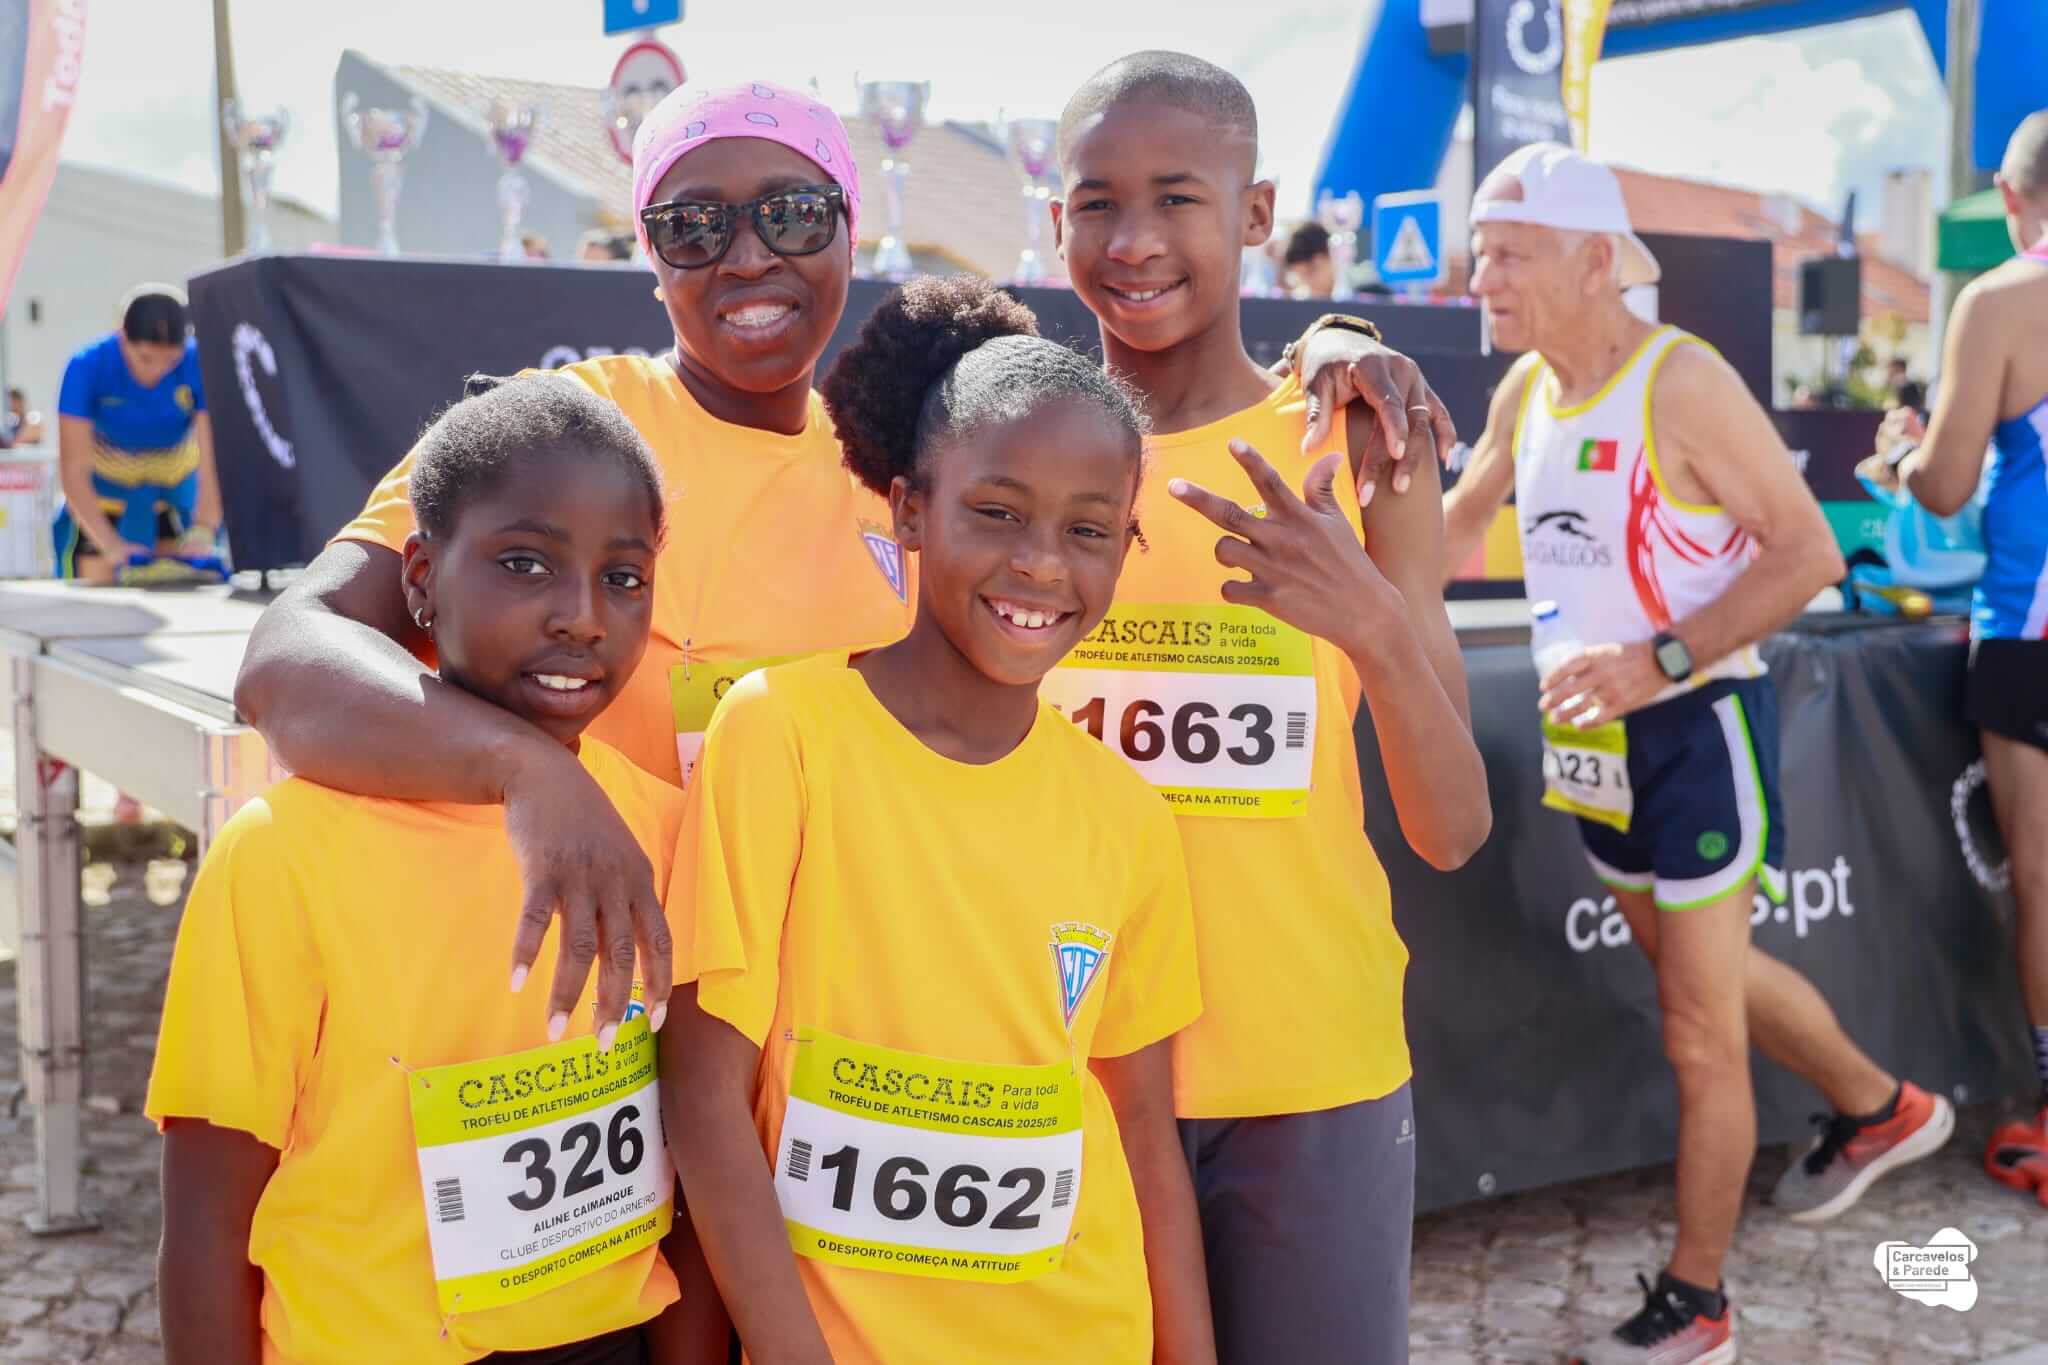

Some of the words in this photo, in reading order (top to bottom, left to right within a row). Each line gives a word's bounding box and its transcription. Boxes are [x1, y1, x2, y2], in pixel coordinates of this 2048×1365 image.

[1082, 619, 1212, 646] ASCAIS
[1219, 622, 1248, 634] Para
[1250, 624, 1277, 635] toda
[1219, 639, 1227, 648] a
[1231, 636, 1257, 648] vida
[1073, 648, 1113, 661] TROFÉU
[1115, 652, 1129, 662] DE
[1130, 652, 1185, 663] ATLETISMO
[1186, 652, 1235, 665] CASCAIS
[1236, 655, 1280, 666] 2025/26
[1071, 697, 1276, 766] 1663
[1160, 792, 1193, 805] MEÇA
[1195, 794, 1211, 804] NA
[1214, 795, 1261, 806] ATITUDE
[614, 1040, 633, 1055] Para
[633, 1031, 648, 1046] toda
[616, 1060, 622, 1070] a
[623, 1051, 639, 1067] vida
[458, 1050, 609, 1108] CASCAIS
[462, 1112, 511, 1129] TROFÉU
[513, 1107, 529, 1120] DE
[531, 1091, 590, 1116] ATLETISMO
[591, 1076, 628, 1099] CASCAIS
[628, 1062, 653, 1085] 2025/26
[832, 1057, 994, 1108] CASCAIS
[1002, 1083, 1032, 1097] Para
[1035, 1083, 1059, 1096] toda
[828, 1088, 873, 1111] TROFÉU
[873, 1101, 890, 1114] DE
[891, 1104, 960, 1124] ATLETISMO
[962, 1115, 1014, 1129] CASCAIS
[1016, 1116, 1058, 1129] 2025/26
[1000, 1100, 1009, 1110] a
[1013, 1099, 1039, 1111] vida
[502, 1104, 645, 1212] 326
[820, 1144, 1046, 1230] 1662
[500, 1241, 540, 1260] CLUBE
[542, 1216, 603, 1249] DESPORTIVO
[604, 1208, 618, 1223] DO
[619, 1192, 656, 1217] ARNEIRO
[533, 1211, 570, 1234] AILINE
[573, 1185, 635, 1223] CAIMANQUE
[500, 1277, 510, 1288] O
[513, 1258, 567, 1286] DESPORTO
[568, 1242, 609, 1265] COMEÇA
[609, 1234, 623, 1247] NA
[624, 1217, 657, 1241] ATITUDE
[817, 1238, 826, 1249] O
[828, 1241, 893, 1260] DESPORTO
[895, 1251, 949, 1268] COMEÇA
[951, 1257, 969, 1269] NA
[970, 1259, 1021, 1272] ATITUDE
